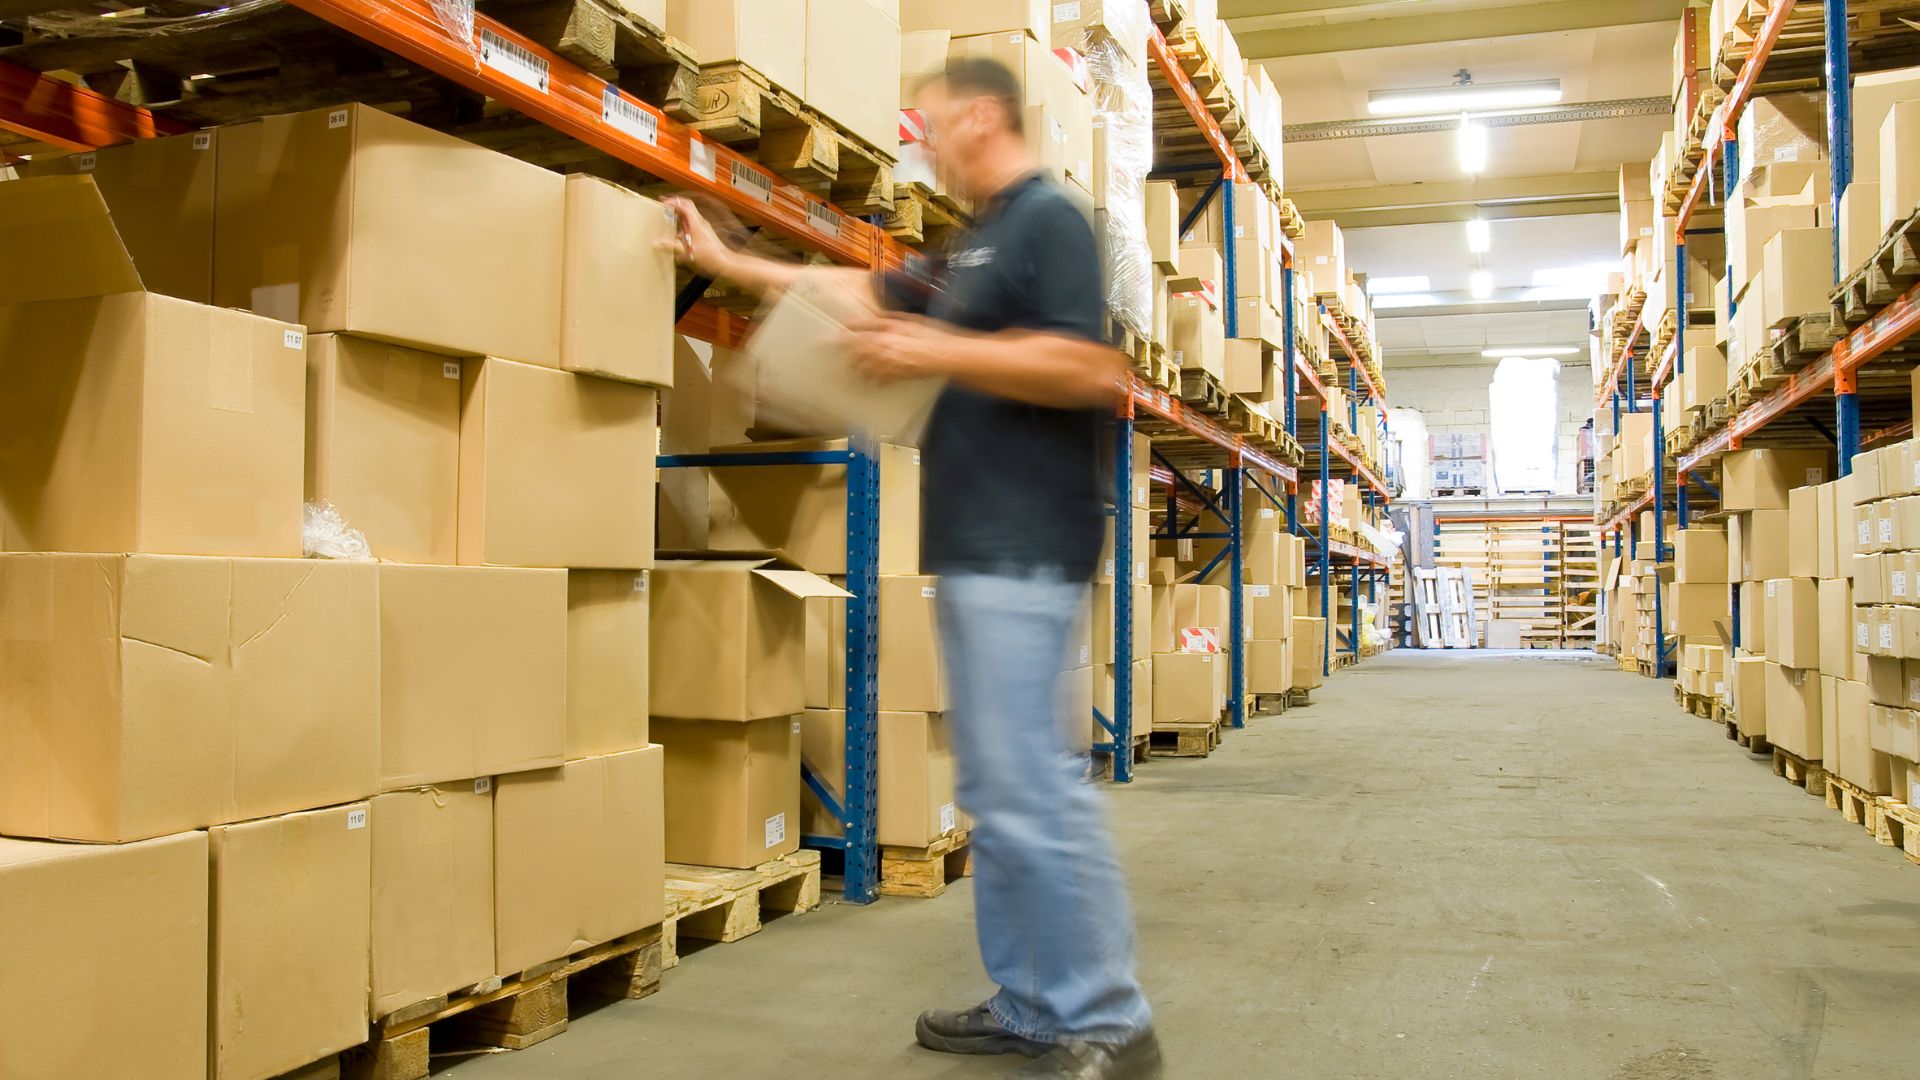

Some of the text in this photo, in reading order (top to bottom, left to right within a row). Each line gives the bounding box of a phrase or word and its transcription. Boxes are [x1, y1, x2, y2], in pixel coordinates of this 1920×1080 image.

[330, 114, 345, 124] 06 09
[294, 336, 301, 344] 07
[350, 814, 365, 824] 11 07
